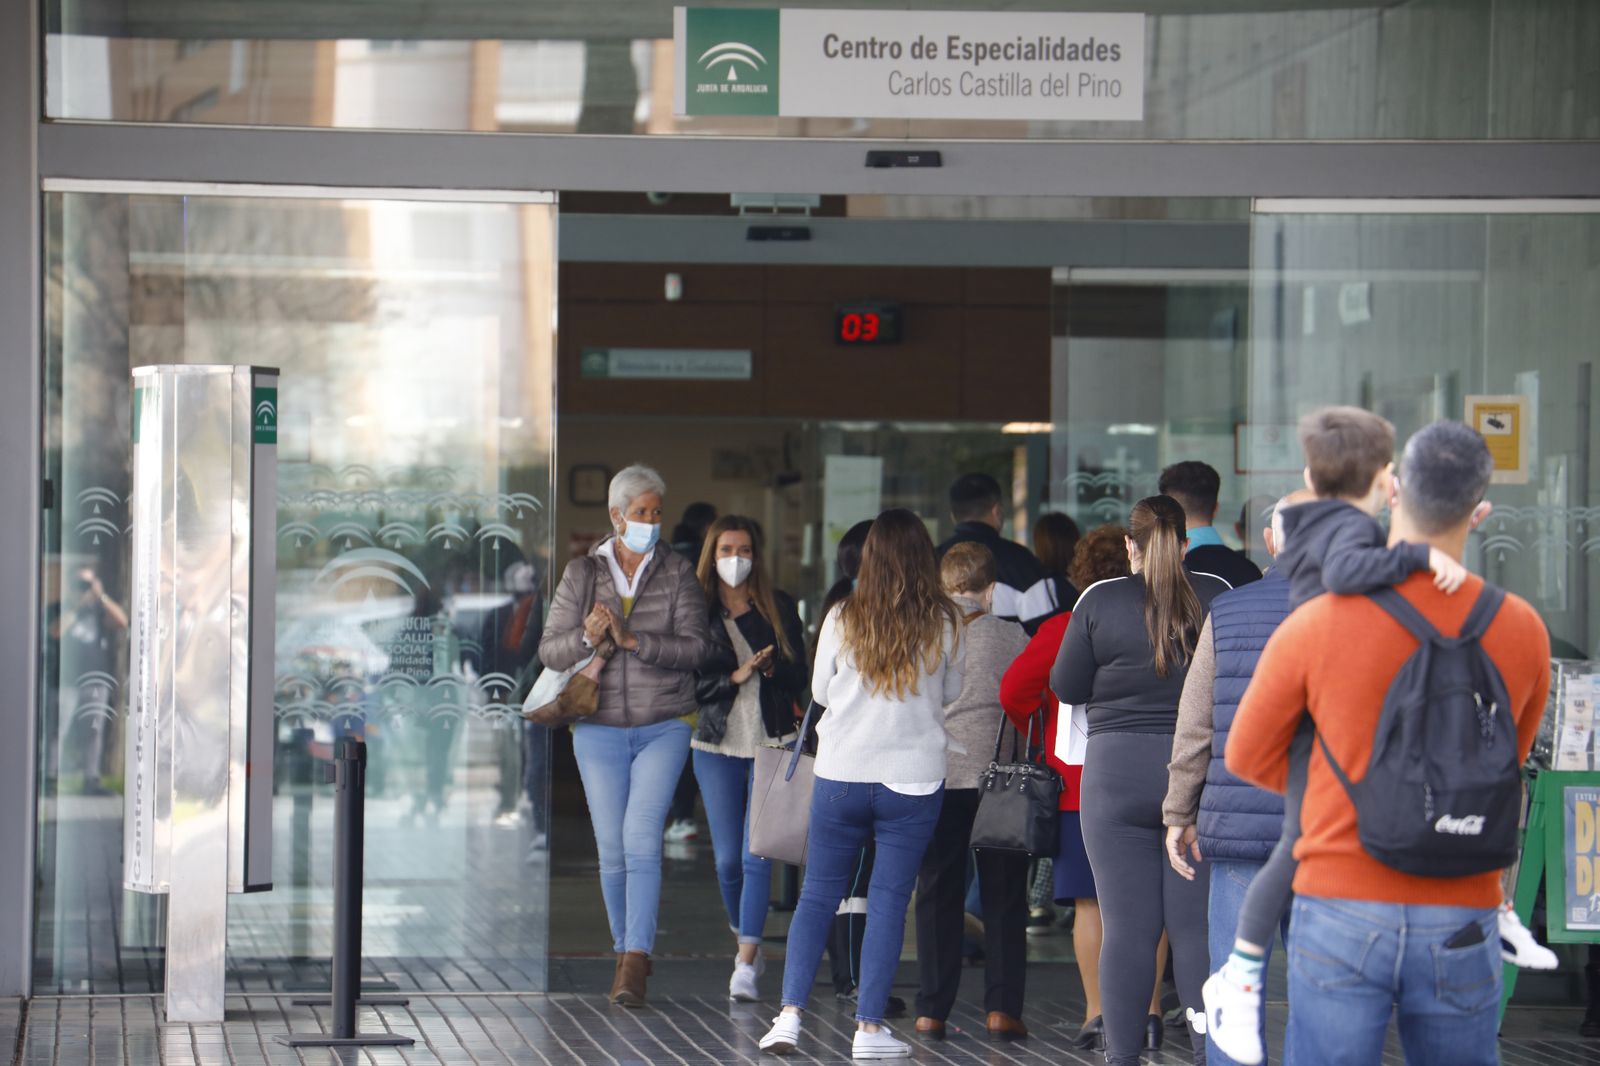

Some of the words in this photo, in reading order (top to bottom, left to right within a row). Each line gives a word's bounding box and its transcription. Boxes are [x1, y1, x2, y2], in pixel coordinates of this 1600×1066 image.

[823, 33, 902, 59] Centro
[910, 35, 938, 60] de
[947, 35, 1121, 66] Especialidades
[888, 70, 952, 96] Carlos
[960, 71, 1032, 97] Castilla
[1040, 72, 1069, 97] del
[1078, 72, 1122, 98] Pino
[841, 313, 879, 341] 03
